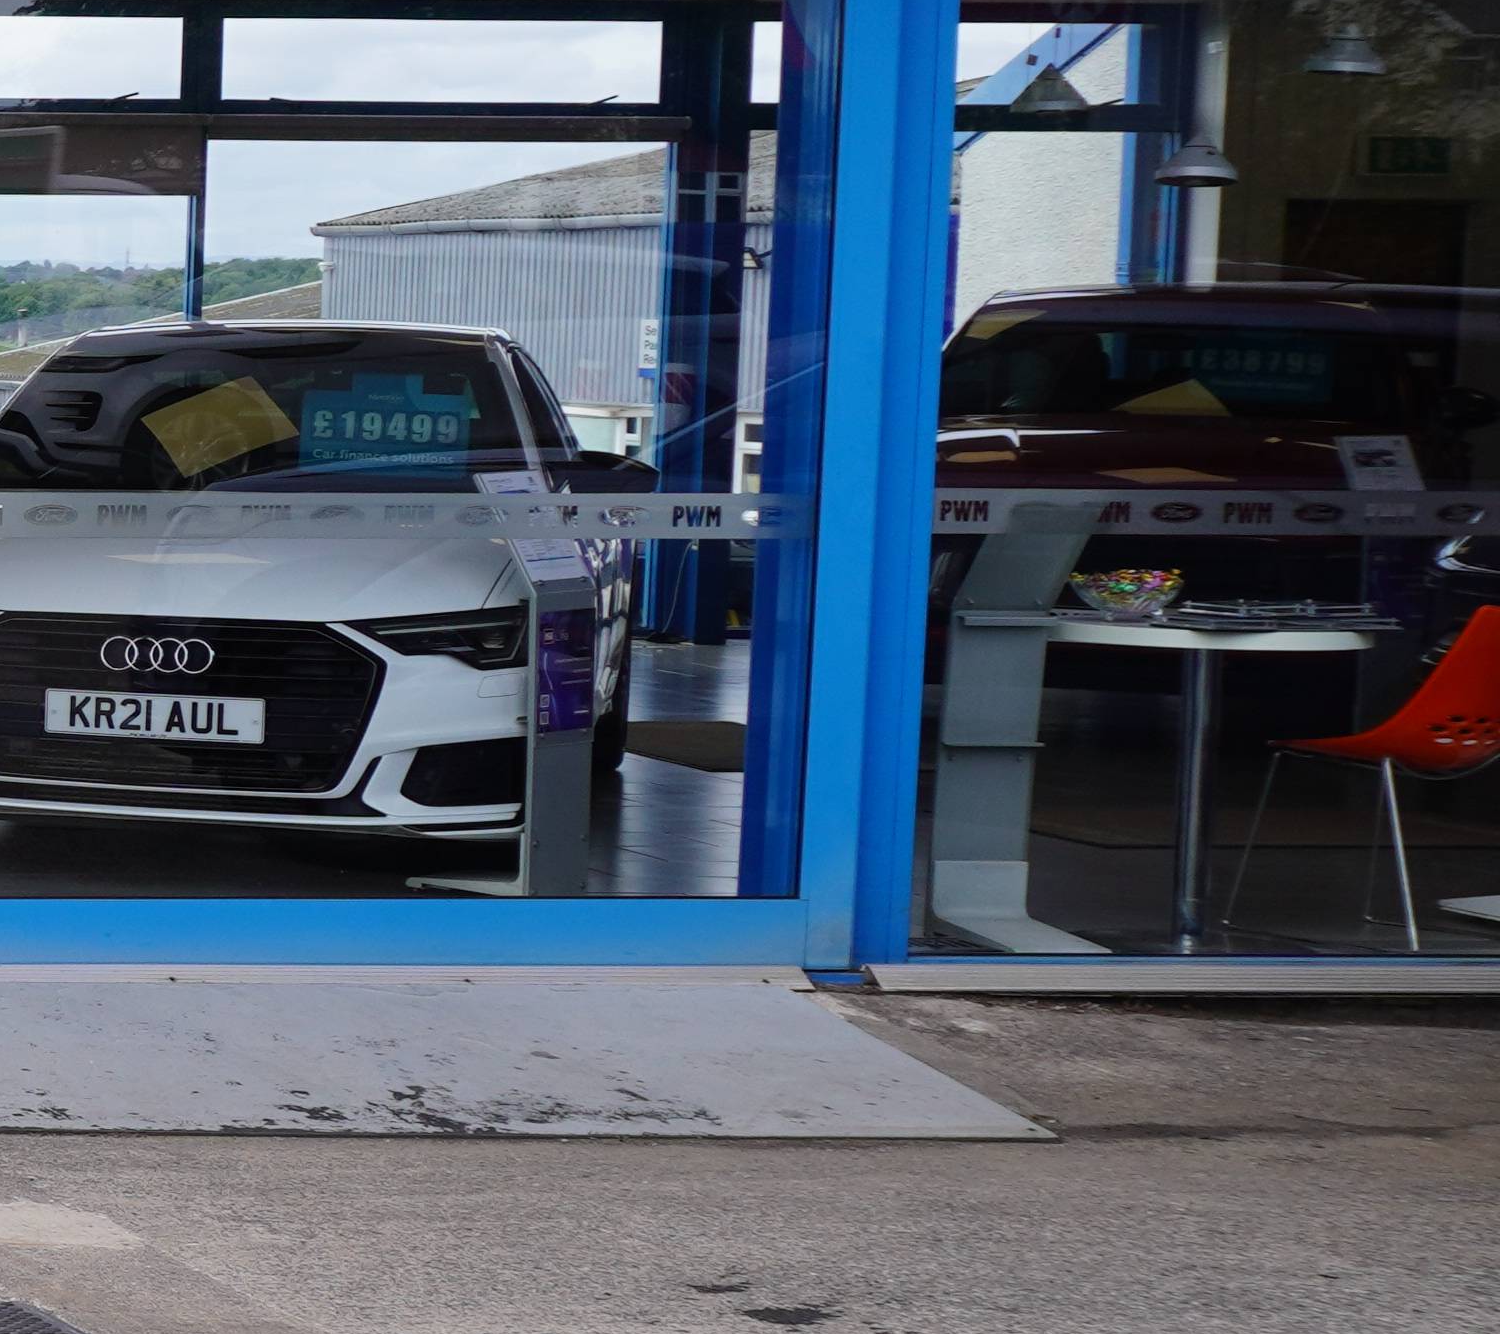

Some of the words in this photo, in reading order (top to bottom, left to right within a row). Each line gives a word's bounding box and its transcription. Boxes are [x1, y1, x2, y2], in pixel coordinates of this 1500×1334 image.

[313, 410, 459, 444] £19499
[312, 449, 336, 460] Car
[339, 449, 389, 463] finance
[391, 452, 456, 465] solutions
[97, 504, 148, 526] PWM
[673, 505, 722, 527] PWM
[939, 500, 989, 522] PWM
[1223, 502, 1275, 524] PWM
[69, 695, 153, 732] KR21
[165, 701, 239, 736] AUL
